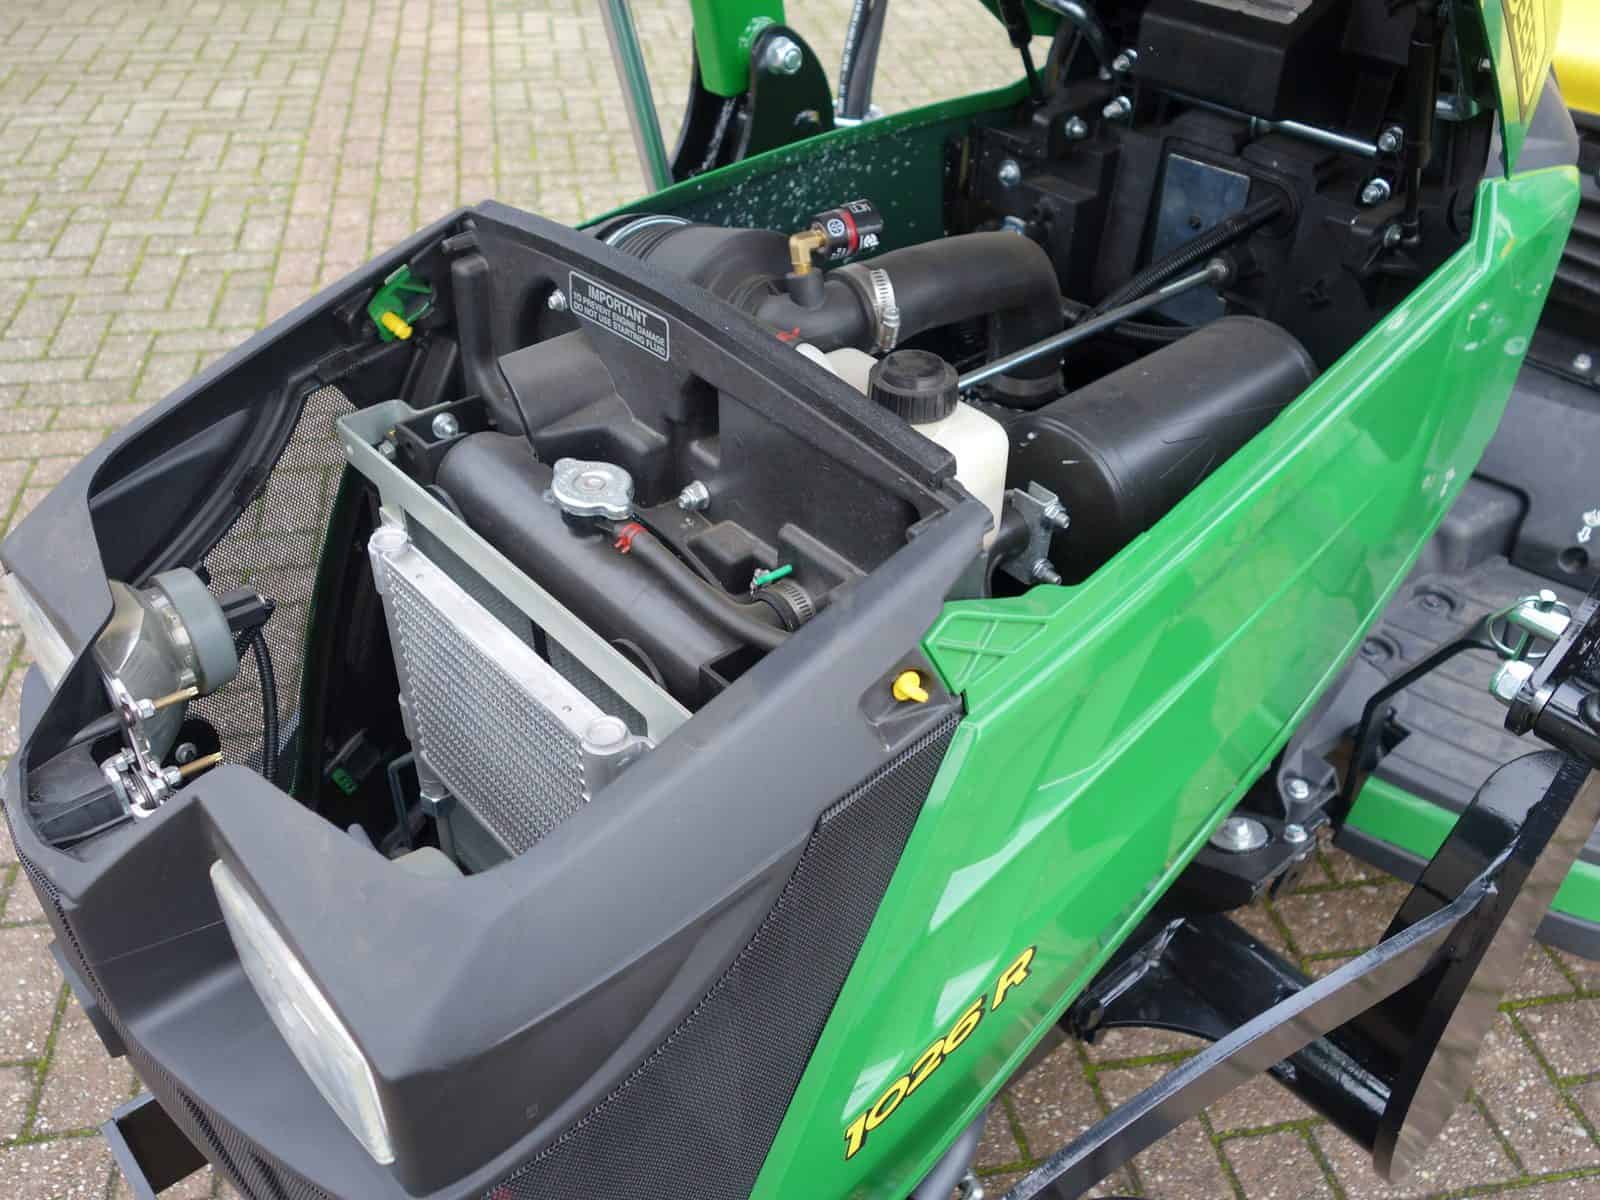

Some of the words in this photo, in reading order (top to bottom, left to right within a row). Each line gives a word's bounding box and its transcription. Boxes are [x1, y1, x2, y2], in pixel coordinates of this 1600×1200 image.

[573, 291, 582, 302] TO
[583, 296, 611, 317] PREVENT
[612, 312, 637, 331] ENGINE
[637, 325, 665, 346] DAMAGE
[573, 301, 583, 312] DO
[584, 306, 598, 320] NOT
[599, 313, 612, 327] USE
[612, 320, 645, 345] STARTING
[646, 339, 665, 356] FLUID
[588, 285, 648, 326] IMPORTANT
